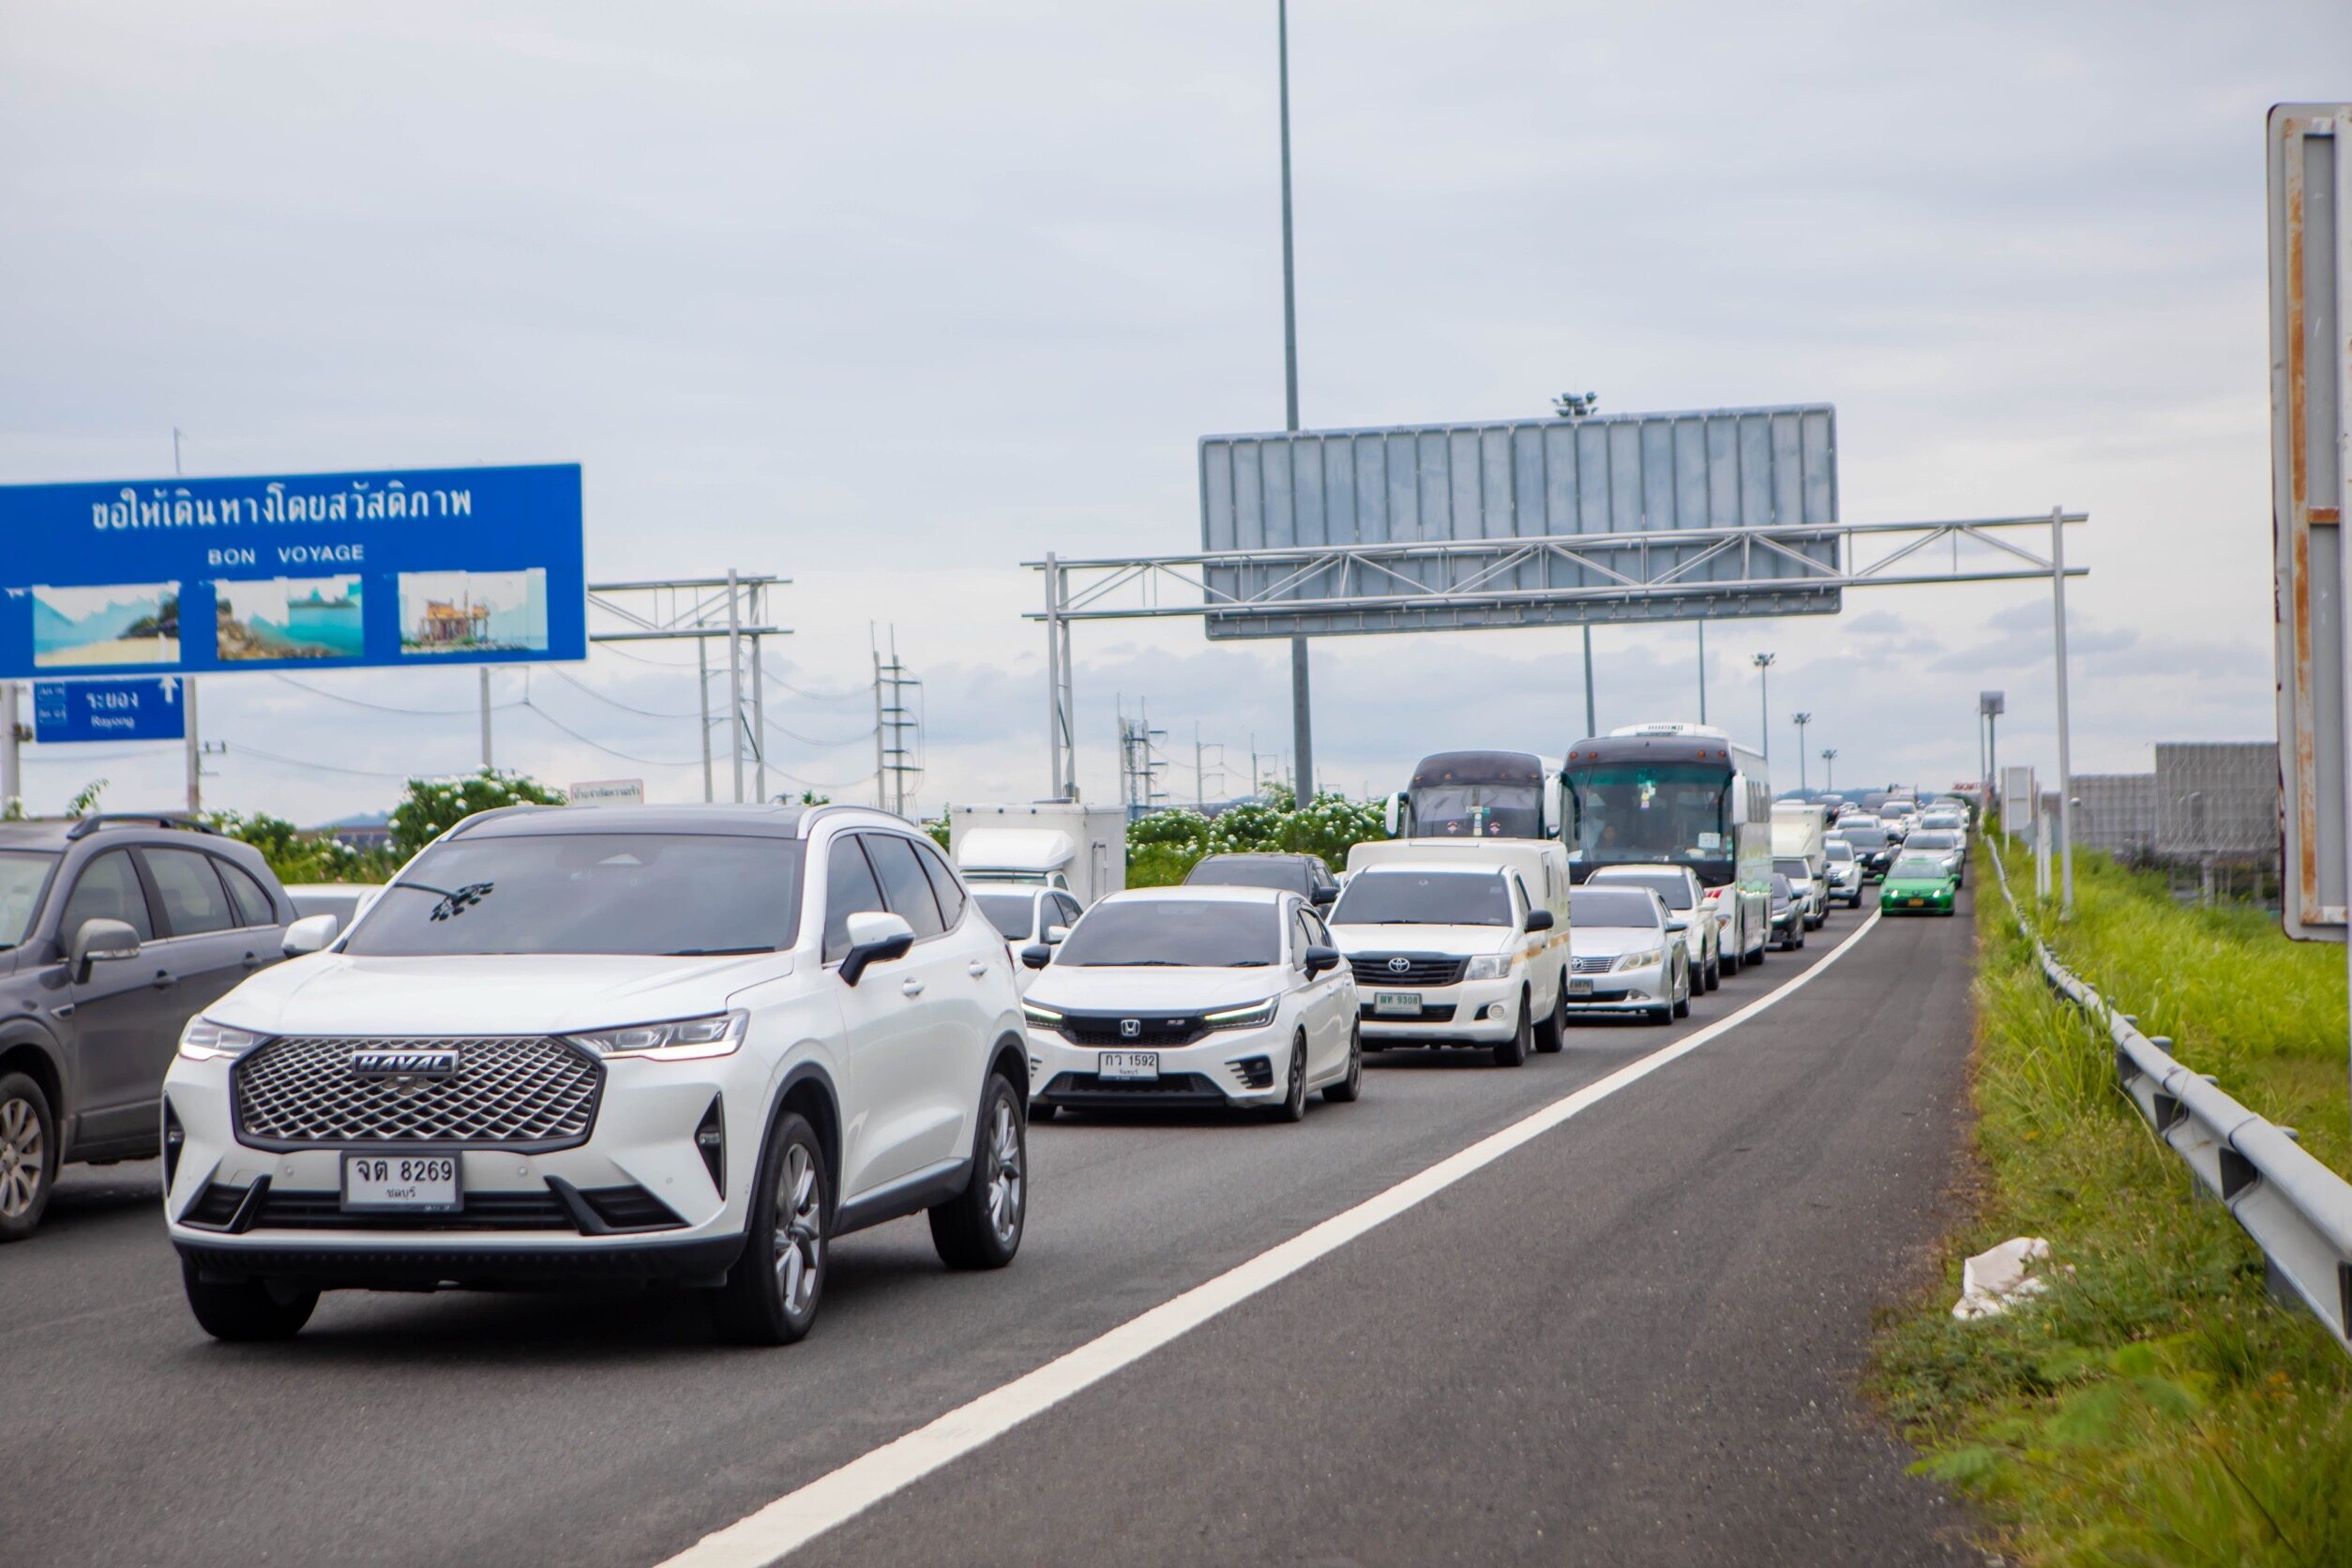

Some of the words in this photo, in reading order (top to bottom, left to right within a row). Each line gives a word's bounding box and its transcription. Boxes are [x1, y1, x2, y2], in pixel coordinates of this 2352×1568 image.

[92, 480, 472, 530] ขอให้เดินทางโดยสวัสดิภาพ
[207, 548, 256, 565] BON
[278, 544, 365, 564] VOYAGE
[86, 691, 139, 709] ระยอง
[357, 1056, 450, 1072] HAVAL
[1106, 1054, 1123, 1066] กว
[1129, 1054, 1155, 1066] 1592
[400, 1160, 453, 1182] 8269
[386, 1185, 416, 1200] ชลบุรี
